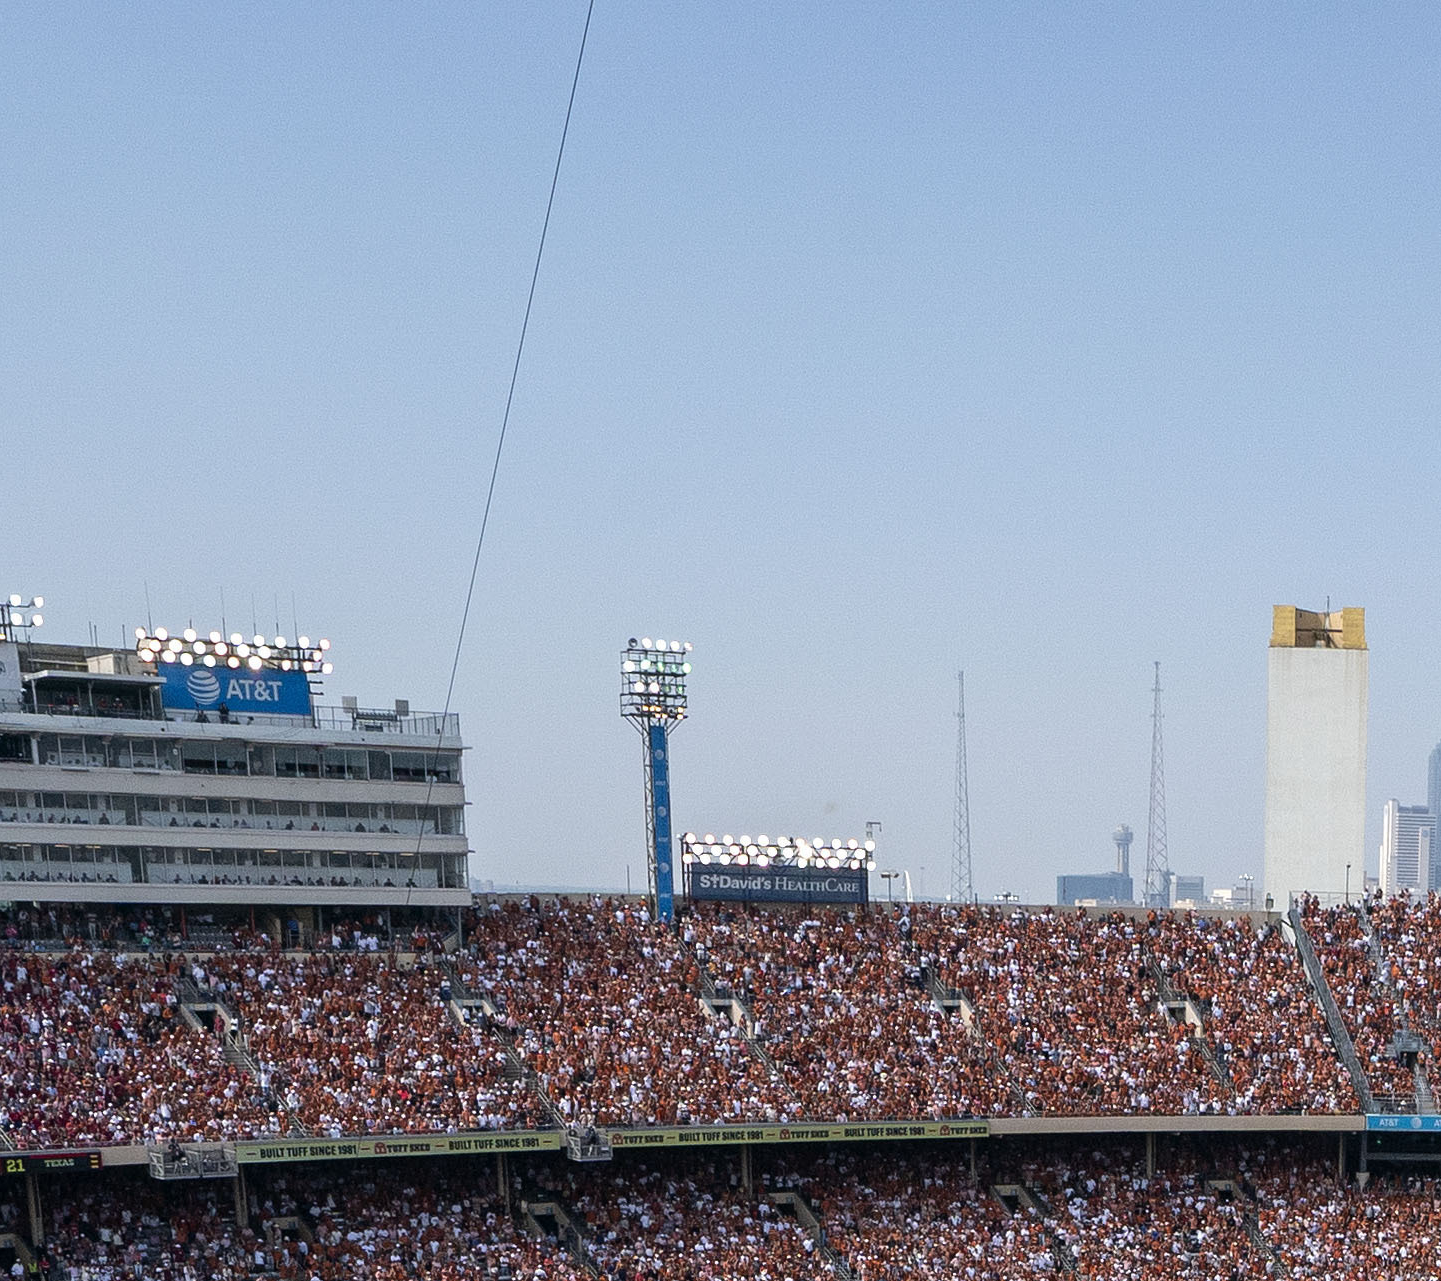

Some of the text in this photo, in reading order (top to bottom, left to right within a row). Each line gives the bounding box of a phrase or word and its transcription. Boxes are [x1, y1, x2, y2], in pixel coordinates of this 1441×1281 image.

[226, 679, 282, 701] AT&T
[1379, 1118, 1398, 1126] AT&T
[678, 1132, 700, 1142] BUILT
[702, 1132, 720, 1141] TUFF
[722, 1131, 745, 1141] SINCE
[746, 1130, 764, 1140] 1981
[844, 1127, 865, 1138] BUILT
[867, 1127, 884, 1137] TUFF
[886, 1126, 908, 1136] SINCE
[909, 1126, 925, 1136] 1981
[260, 1147, 285, 1158] BUILT
[287, 1146, 308, 1157] TUFF
[310, 1145, 337, 1156] SINCE
[338, 1144, 357, 1155] 1981
[448, 1140, 472, 1151] BUILT
[473, 1139, 494, 1150] TUFF
[495, 1138, 520, 1149] SINCE
[521, 1138, 540, 1148] 1981
[6, 1158, 74, 1172] 21 TEXAS
